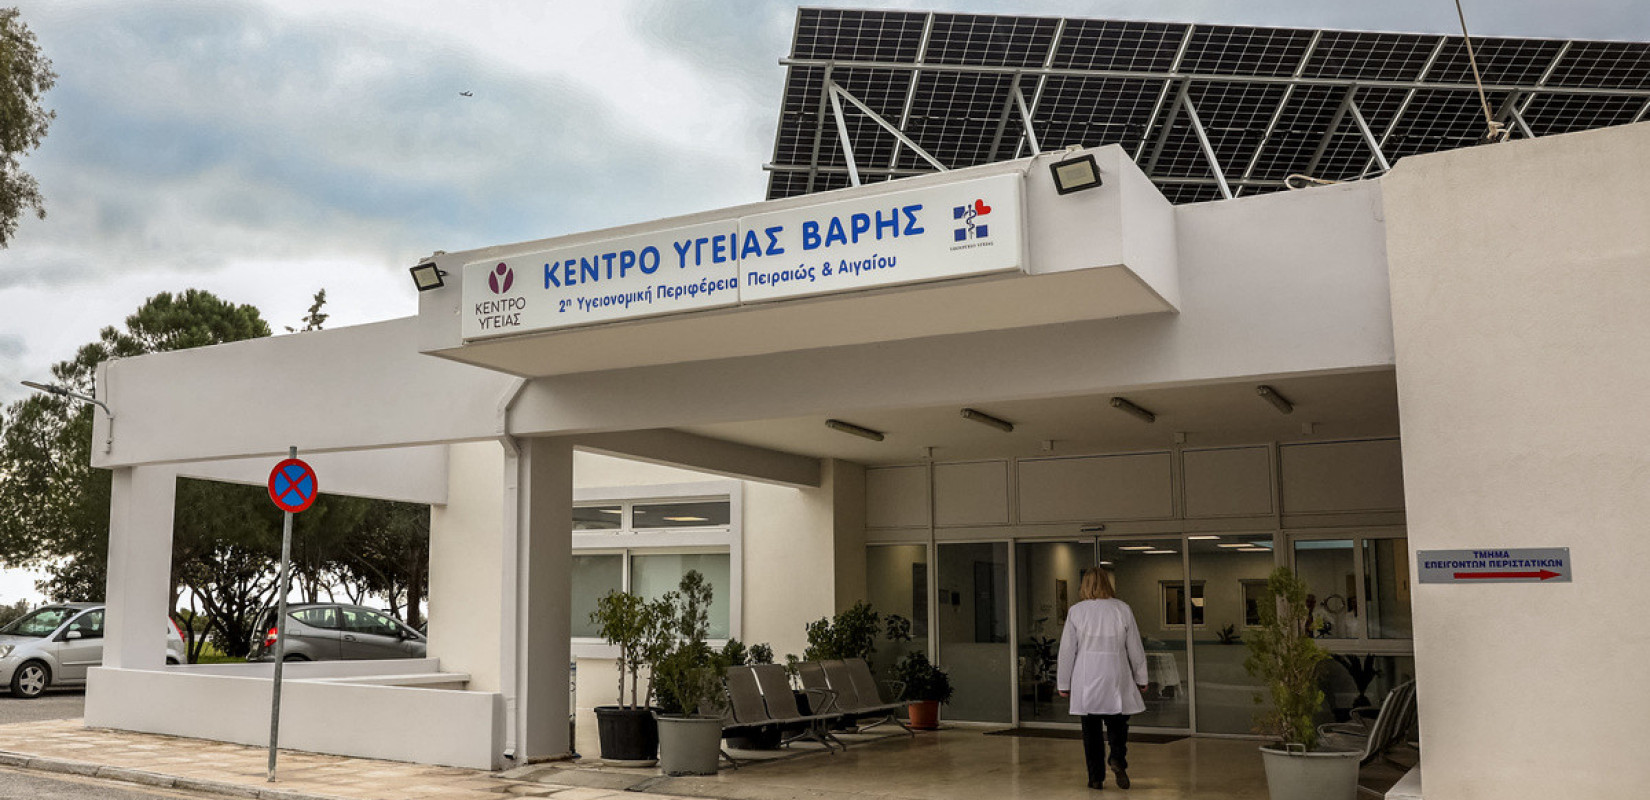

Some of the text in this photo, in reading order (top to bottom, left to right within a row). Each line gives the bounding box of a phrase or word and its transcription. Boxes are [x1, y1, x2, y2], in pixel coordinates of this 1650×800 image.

[543, 204, 925, 289] ΚΕΝΤΡΟ ΥΓΕΙΑΣ ΒΑΡΗΣ
[577, 286, 652, 312] Υγειονομική
[656, 277, 738, 299] Περιφέρεια
[748, 264, 815, 287] Πειραιώς
[821, 262, 833, 276] &
[838, 254, 896, 276] Αιγαίου
[475, 296, 526, 315] ΚΕΝΤΡΟ
[478, 313, 521, 330] ΥΓΕΙΑΣ
[1424, 559, 1563, 569] ΕΠΕΙΓΟΝΤΩΝ ΠΕΡΙΣΤΑΤΙΚΩΝ
[1473, 551, 1510, 559] ΤΜΗΜΑ
